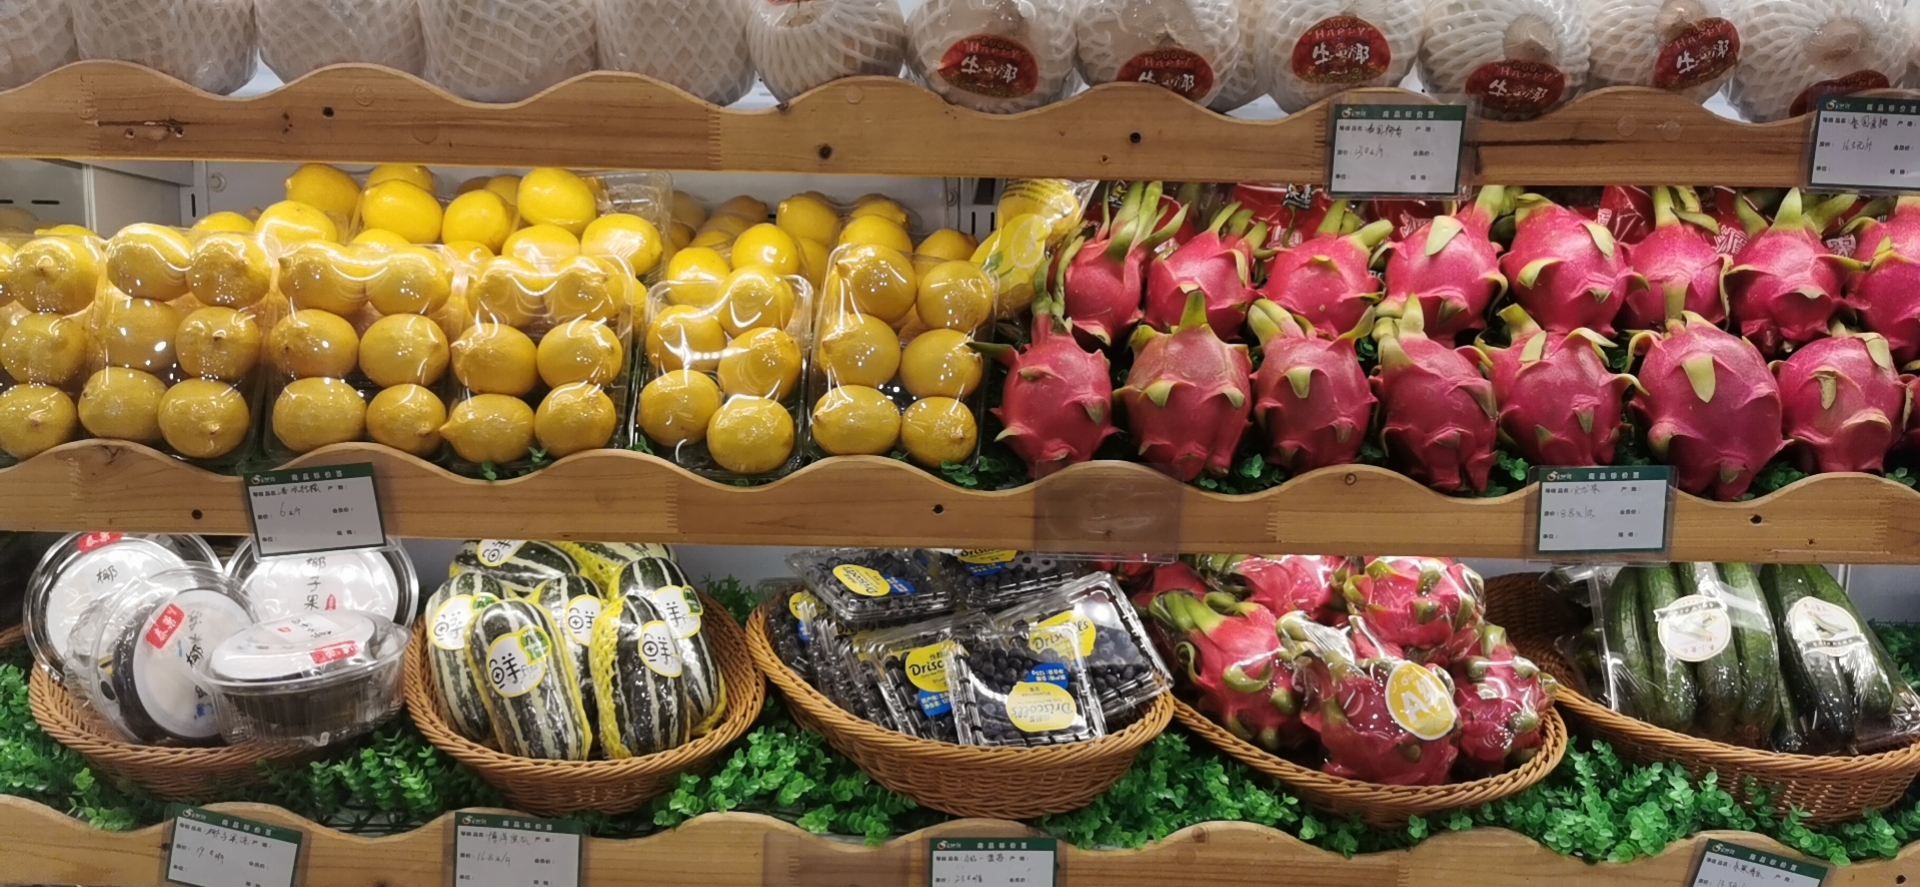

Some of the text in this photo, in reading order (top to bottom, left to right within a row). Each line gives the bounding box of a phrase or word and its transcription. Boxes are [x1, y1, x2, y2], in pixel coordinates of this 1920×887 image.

[1315, 27, 1366, 39] HAPPY
[1674, 23, 1722, 49] HAPPY
[969, 42, 1020, 58] HAPPY
[1145, 57, 1191, 67] HAPPY
[1500, 66, 1552, 81] HAPPY
[96, 565, 118, 584] 椰
[489, 652, 521, 689] 鲜
[908, 660, 945, 676] Drisc
[1011, 703, 1074, 719] Driscoll's
